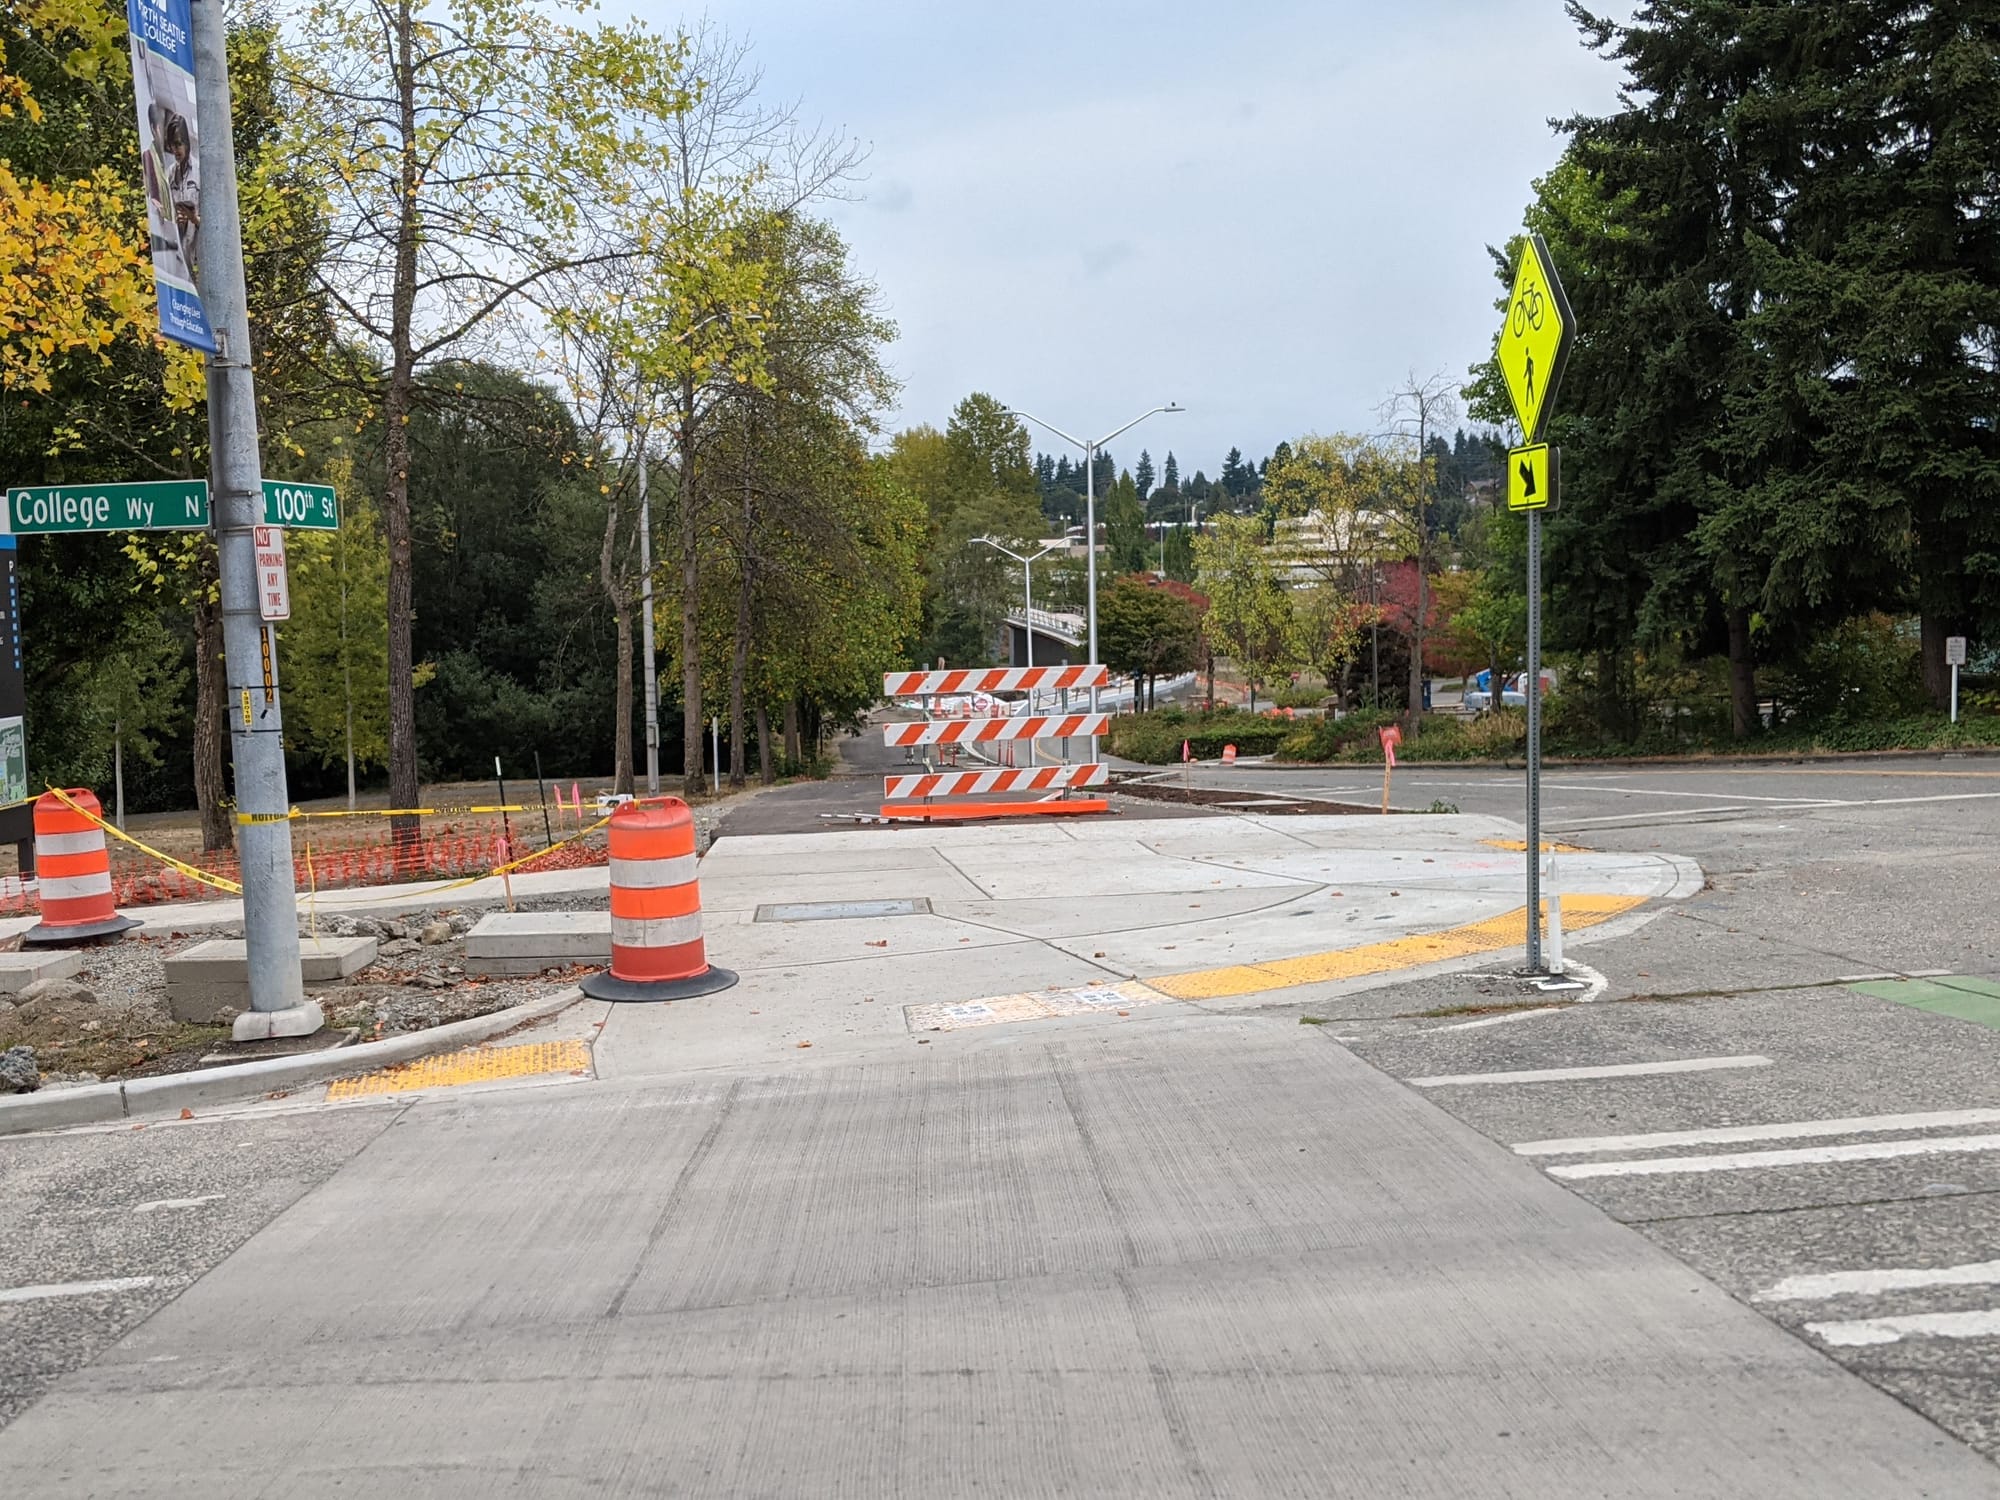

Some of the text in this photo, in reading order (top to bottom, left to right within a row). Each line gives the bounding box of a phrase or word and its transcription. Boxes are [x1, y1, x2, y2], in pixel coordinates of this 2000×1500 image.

[143, 22, 176, 53] COLLEGE
[160, 16, 186, 45] SEATTLE
[16, 491, 200, 528] College Wy N
[274, 487, 315, 521] 100th
[321, 496, 334, 519] St
[256, 528, 269, 545] NO
[259, 553, 283, 567] PARKING
[267, 573, 278, 586] ANY
[267, 592, 281, 607] TIME
[261, 627, 274, 702] 10002
